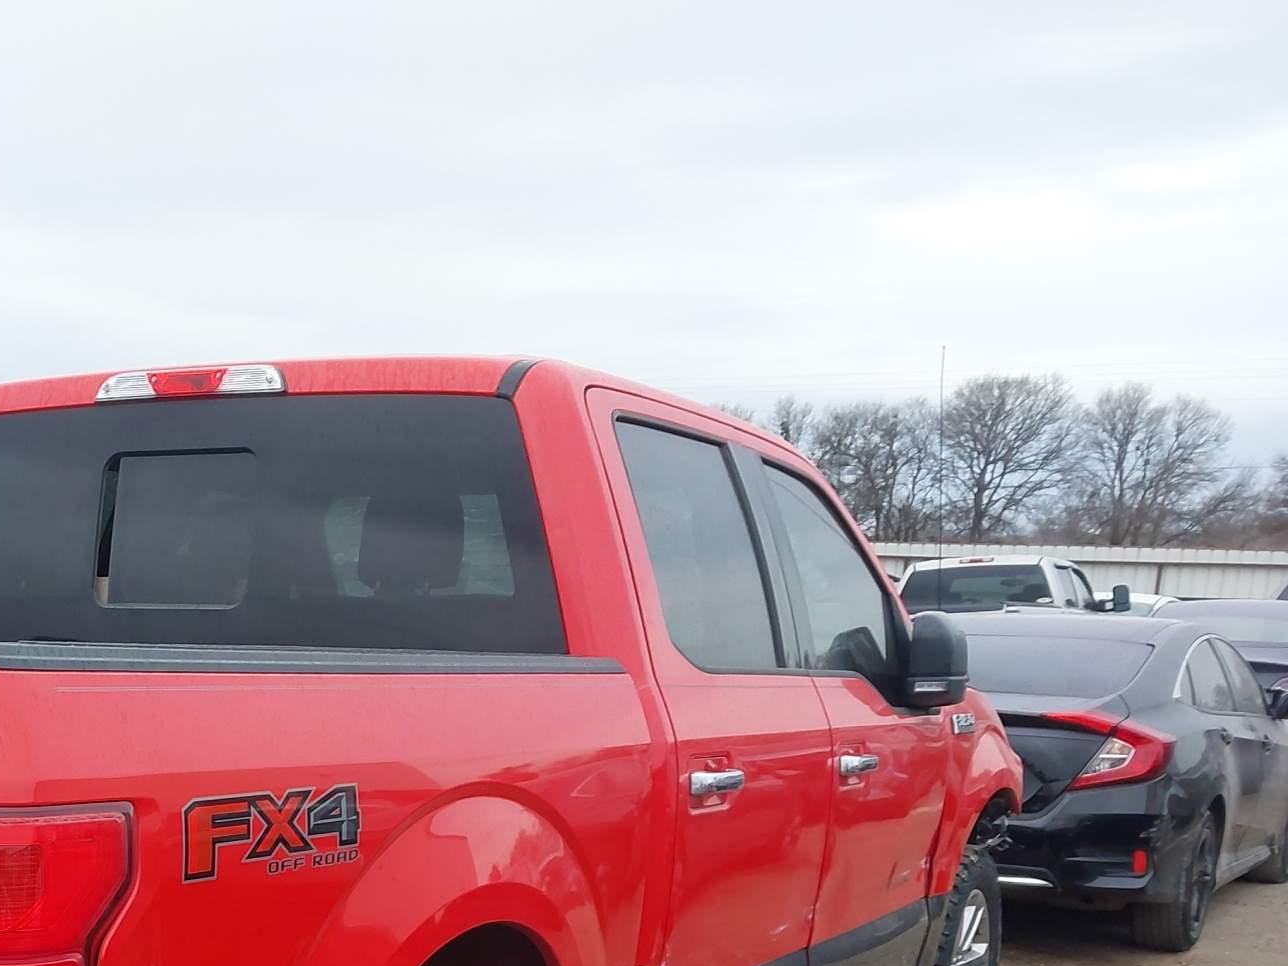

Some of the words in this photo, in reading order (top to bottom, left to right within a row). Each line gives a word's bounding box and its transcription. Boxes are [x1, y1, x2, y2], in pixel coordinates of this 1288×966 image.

[182, 783, 361, 884] FX4
[267, 856, 305, 875] OFF
[312, 849, 361, 868] ROAD
